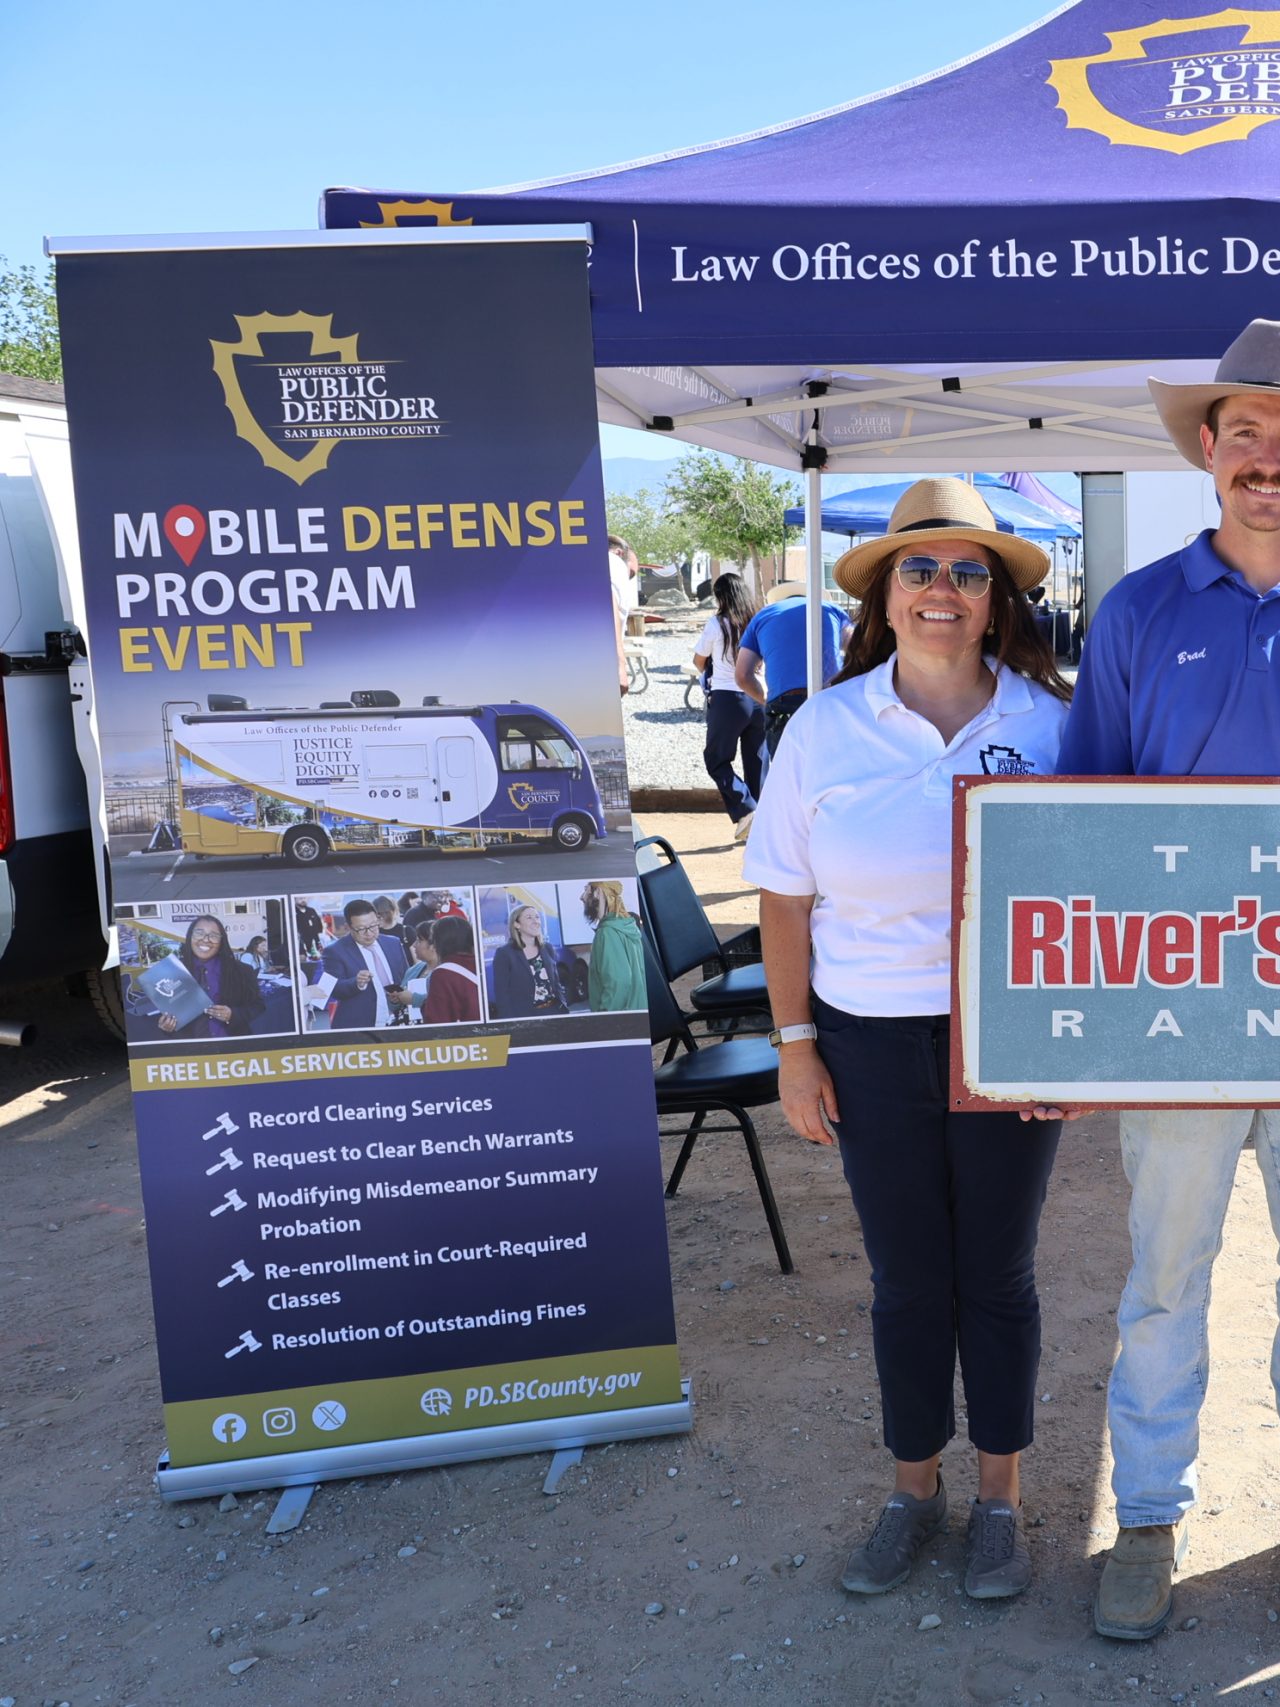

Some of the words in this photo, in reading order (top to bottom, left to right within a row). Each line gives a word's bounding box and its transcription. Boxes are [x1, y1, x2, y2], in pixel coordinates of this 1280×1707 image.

[1172, 57, 1217, 69] LAW
[1165, 109, 1218, 119] SAN
[671, 246, 760, 281] Law
[772, 242, 921, 280] Offices
[933, 239, 980, 278] of
[989, 239, 1058, 278] the
[1071, 235, 1210, 277] Public
[278, 368, 302, 377] LAW
[304, 367, 346, 376] OFFICES
[348, 366, 363, 375] OF
[364, 365, 386, 374] THE
[280, 376, 387, 400] PUBLIC
[281, 398, 438, 423] DEFENDER
[284, 429, 308, 439] SAN
[312, 427, 388, 438] BERNARDINO
[391, 425, 441, 435] COUNTY
[341, 500, 588, 551] DEFENSE
[115, 565, 416, 618] PROGRAM
[118, 622, 312, 673] EVENT
[1177, 647, 1206, 665] Brad
[361, 724, 403, 732] Defender
[293, 738, 352, 751] JUSTICE
[294, 751, 352, 764] EQUITY
[296, 764, 360, 777] DIGNITY
[521, 795, 560, 803] COUNTY
[146, 1062, 200, 1084] FREE
[204, 1058, 276, 1081] LEGAL
[281, 1050, 384, 1075] SERVICES
[387, 1044, 488, 1068] INCLUDE:
[248, 1105, 321, 1129] Record
[325, 1100, 408, 1127] Clearing
[410, 1096, 493, 1117] Services
[253, 1146, 338, 1170] Request
[340, 1145, 362, 1161] to
[365, 1140, 418, 1160] Clear
[421, 1135, 482, 1157] Bench
[485, 1127, 575, 1152] Warrants
[257, 1184, 363, 1211] Modifying
[365, 1175, 501, 1202] Misdemeanor
[505, 1165, 598, 1188] Summary
[260, 1216, 362, 1241] Probation
[264, 1249, 410, 1281] Re-enrollment
[414, 1251, 433, 1266] in
[437, 1232, 588, 1264] Court-Required
[267, 1289, 342, 1311] Classes
[272, 1326, 379, 1351] Resolution
[383, 1321, 405, 1340] of
[408, 1309, 533, 1337] Outstanding
[536, 1302, 587, 1320] Fines
[464, 1370, 642, 1409] PD.SBCounty.gov
